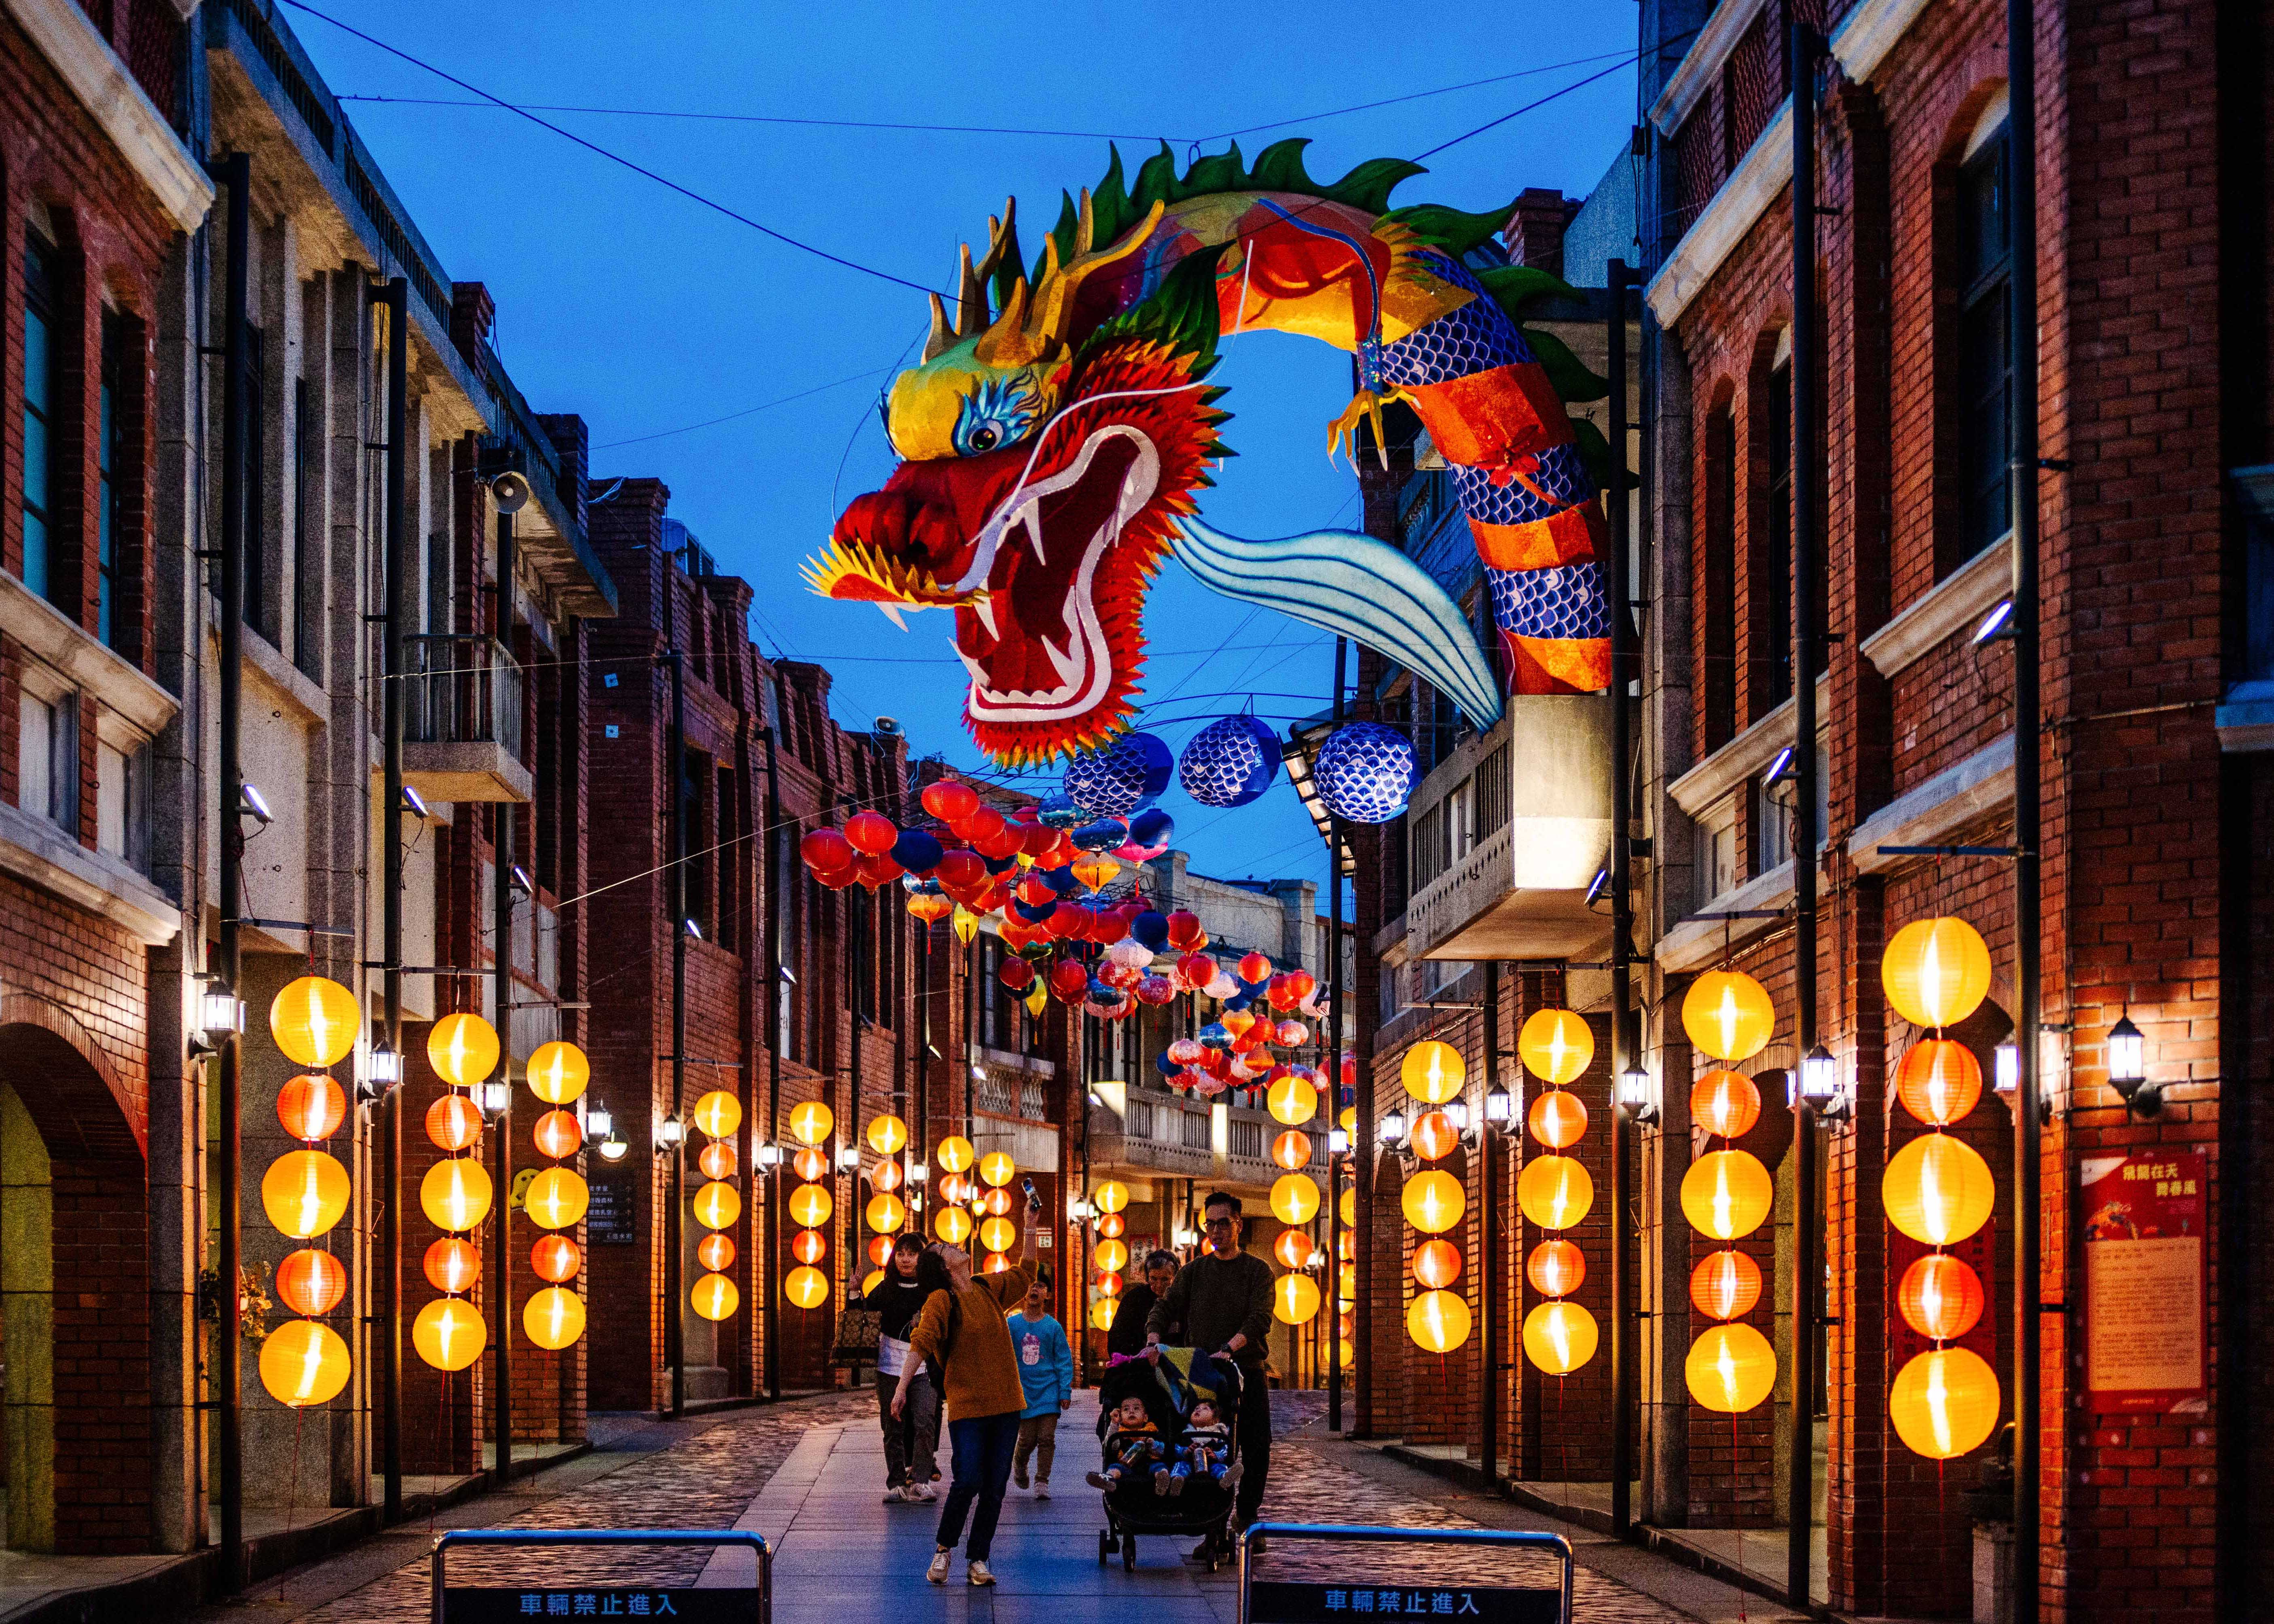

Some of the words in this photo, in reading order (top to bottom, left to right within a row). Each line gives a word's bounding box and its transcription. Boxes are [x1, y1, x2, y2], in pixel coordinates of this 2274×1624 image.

[520, 1594, 677, 1616] 車輛禁止進入
[1325, 1590, 1480, 1614] 車輛禁止進入
